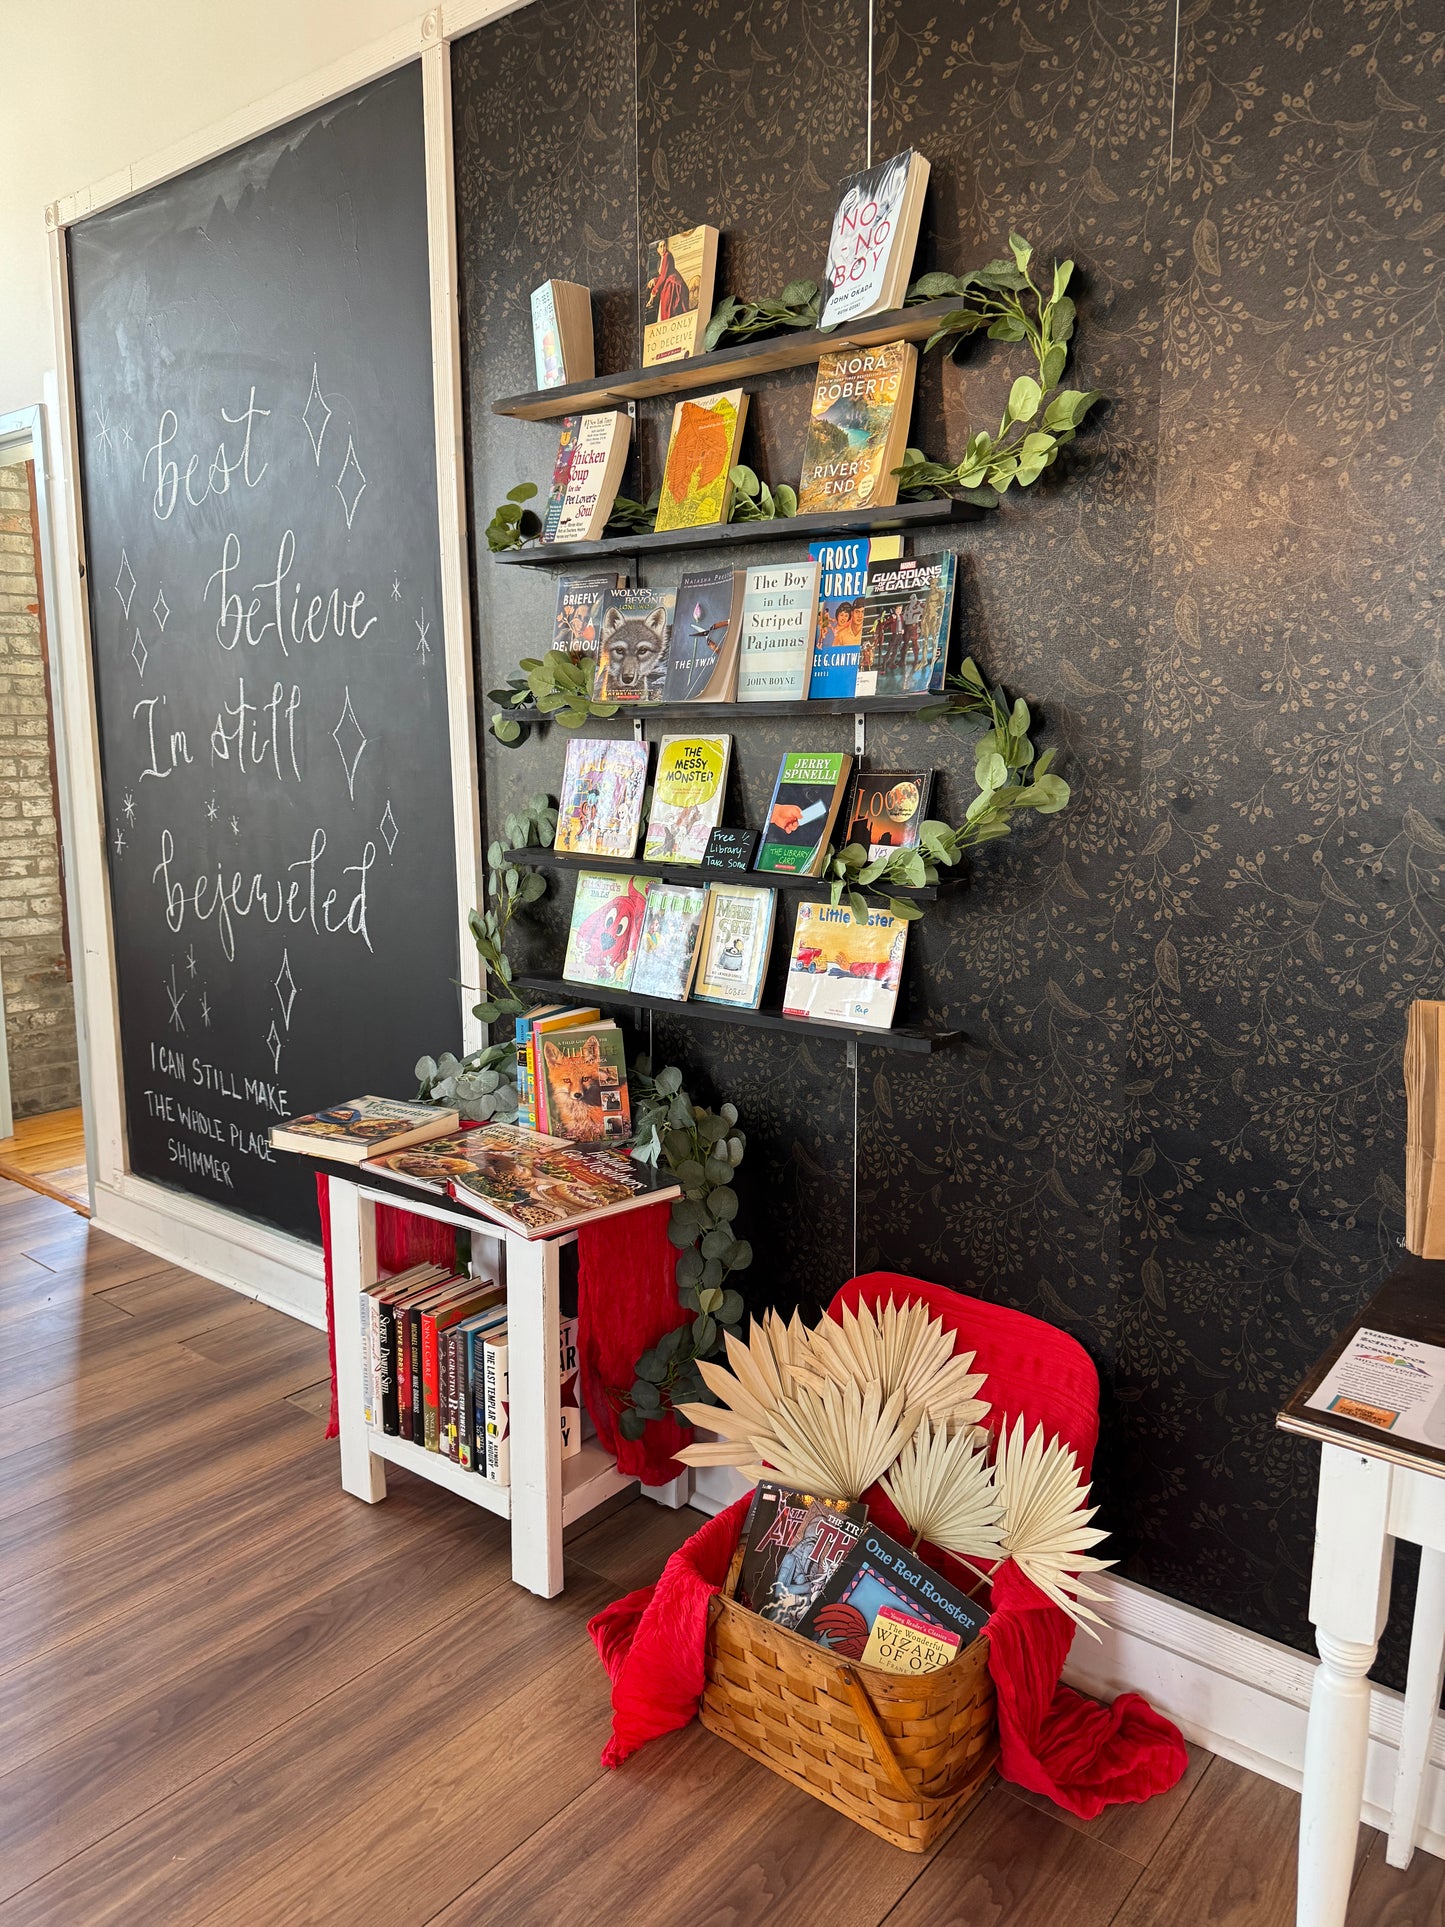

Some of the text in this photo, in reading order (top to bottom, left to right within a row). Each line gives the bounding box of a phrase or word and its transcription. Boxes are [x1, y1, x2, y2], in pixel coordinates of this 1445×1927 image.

[841, 202, 877, 235] NO
[834, 247, 884, 288] BOY
[830, 293, 849, 306] JOHN
[850, 282, 873, 299] OKADA
[649, 317, 693, 339] AND ONLY
[647, 330, 693, 353] TO DECEIVE
[835, 355, 887, 376] NORA
[816, 375, 898, 401] ROBERTS
[143, 386, 270, 520] best
[571, 443, 606, 464] Chicken
[568, 466, 589, 485] Soup
[814, 460, 871, 479] RIVER'S
[824, 480, 855, 494] END
[565, 494, 597, 505] Pet Lover's
[575, 505, 594, 518] Soul
[818, 544, 859, 571] CROSS
[684, 577, 711, 585] NATASHA
[754, 571, 808, 590] The Boy
[872, 564, 942, 583] GUARDIANS
[885, 574, 941, 590] GALAXY
[204, 530, 377, 656] believe
[563, 592, 599, 606] BRIEFLY,
[610, 588, 652, 597] WOLVES
[625, 596, 666, 604] BEYOND
[763, 594, 794, 607] in the
[588, 617, 594, 627] A
[751, 612, 803, 631] Striped
[747, 635, 804, 651] Pajamas
[675, 656, 716, 670] THE TWIN
[747, 676, 795, 687] JOHN BOYNE
[212, 677, 300, 782] still
[685, 747, 702, 757] THE
[675, 758, 708, 770] MESSY
[794, 758, 831, 769] JERRY
[666, 770, 714, 783] MONSTER
[783, 769, 838, 780] SPINELLI
[852, 788, 906, 822] LOOK
[713, 830, 736, 842] Free
[706, 855, 724, 868] Take
[770, 848, 810, 859] THE LIBRARY
[779, 856, 796, 865] CARD
[874, 847, 888, 858] YES
[153, 829, 375, 961] bejeweled
[819, 907, 850, 923] Little
[151, 1042, 292, 1115] I CAN STILL MAKE
[364, 1100, 432, 1118] Vegetarian
[144, 1091, 277, 1163] THE WHOLE PLACE
[167, 1139, 235, 1188] SHIMMER
[587, 1150, 637, 1172] Holiday
[380, 1314, 390, 1343] SECRETS
[423, 1319, 431, 1349] JOHN LE
[1354, 1343, 1426, 1364] Resources
[474, 1340, 483, 1409] PHILLIP MARGOLIN
[486, 1350, 496, 1420] THE LAST TEMPLAR
[449, 1398, 458, 1409] R
[828, 1515, 844, 1530] THE
[865, 1538, 976, 1629] One Red Rooster
[890, 1611, 948, 1641] Young Reader's Classics
[888, 1621, 944, 1652] The Wonderful
[876, 1626, 949, 1667] WIZARD
[880, 1644, 937, 1675] OF OZ
